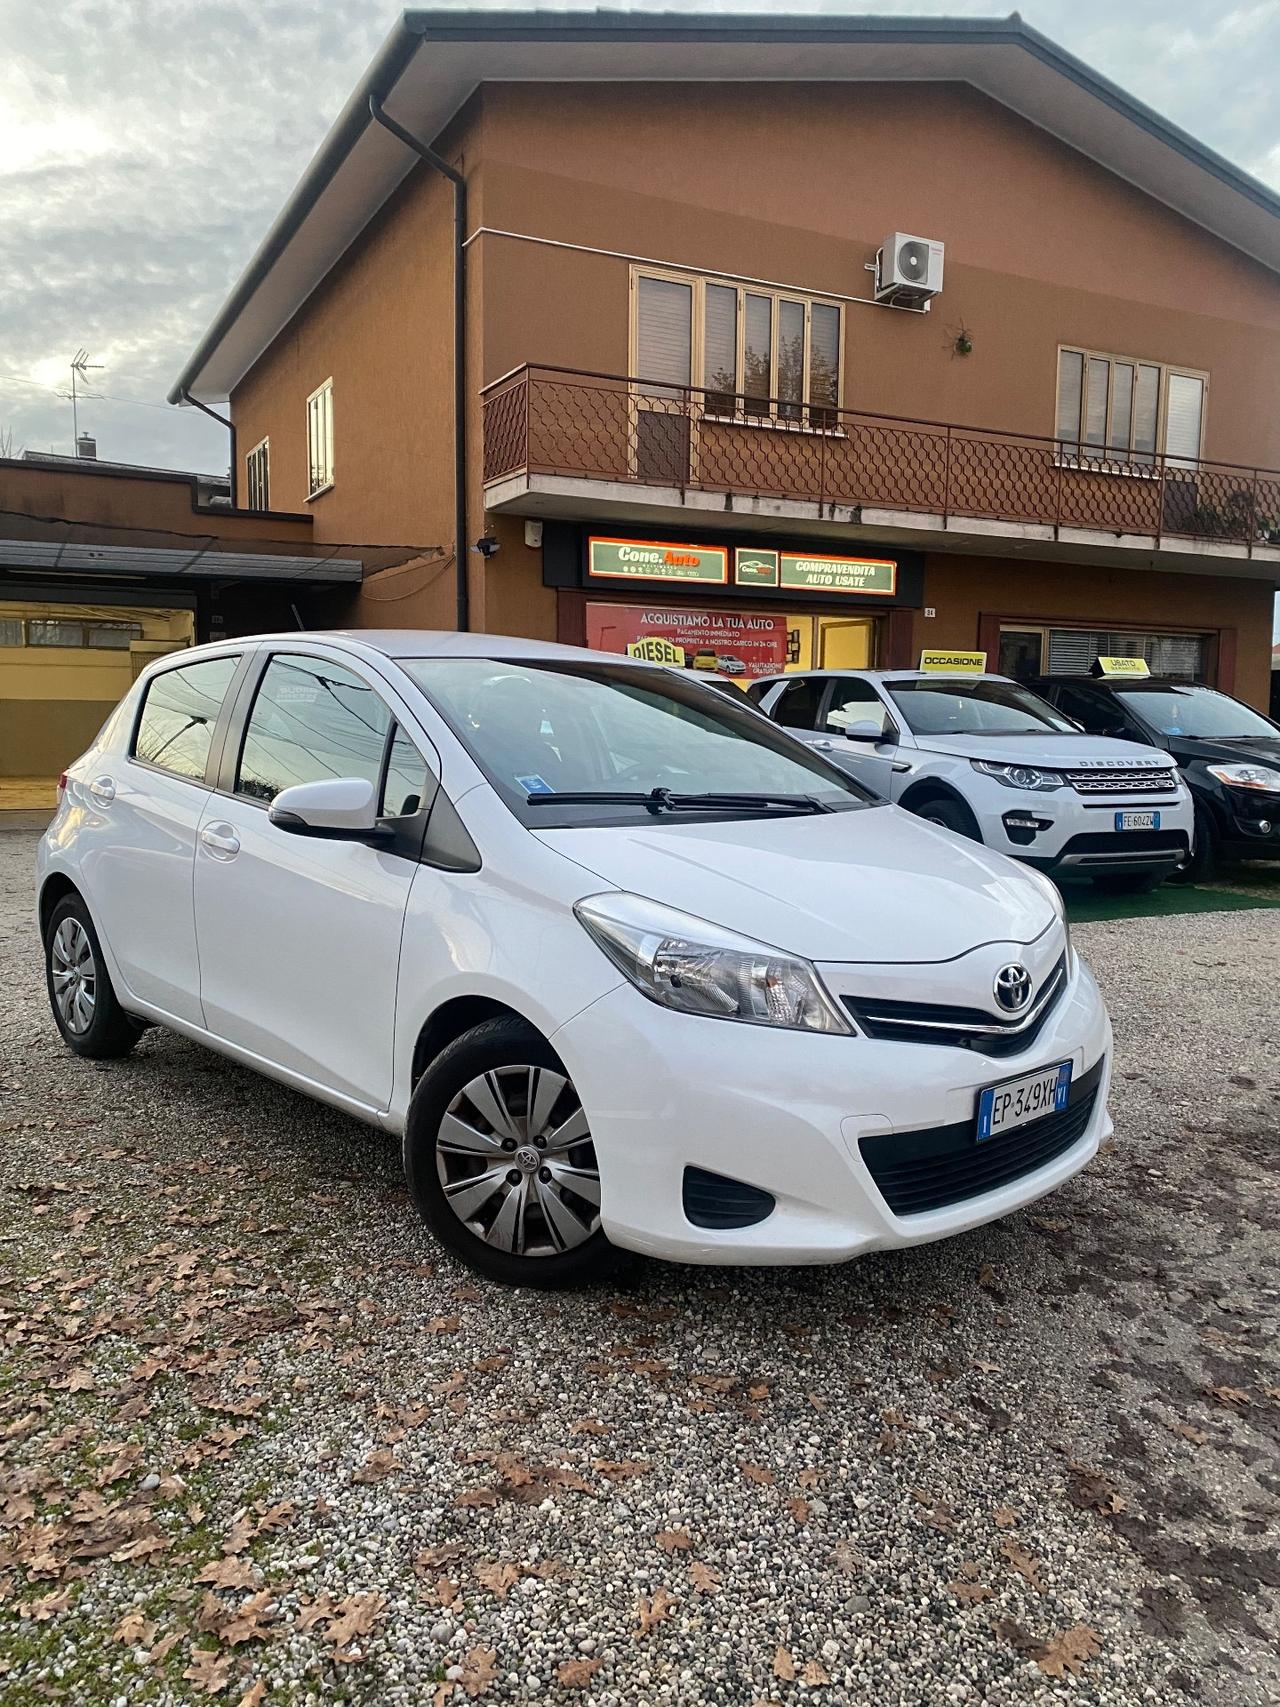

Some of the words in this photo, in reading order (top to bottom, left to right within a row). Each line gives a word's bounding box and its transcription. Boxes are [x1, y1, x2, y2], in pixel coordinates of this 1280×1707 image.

[796, 561, 876, 576] COMPRAVENDITA
[806, 574, 833, 585] AUTO
[835, 576, 866, 587] USATE
[640, 613, 710, 627] ACQUISTIAMO
[712, 617, 724, 628] LA
[726, 617, 745, 629] TUA
[747, 619, 774, 630] AUTO
[677, 629, 709, 637] PAGAMENTO
[633, 641, 680, 663] DIESEL
[924, 656, 984, 667] OCCASIONE
[1110, 659, 1136, 667] USATO
[1079, 760, 1160, 768] DISCOVERY
